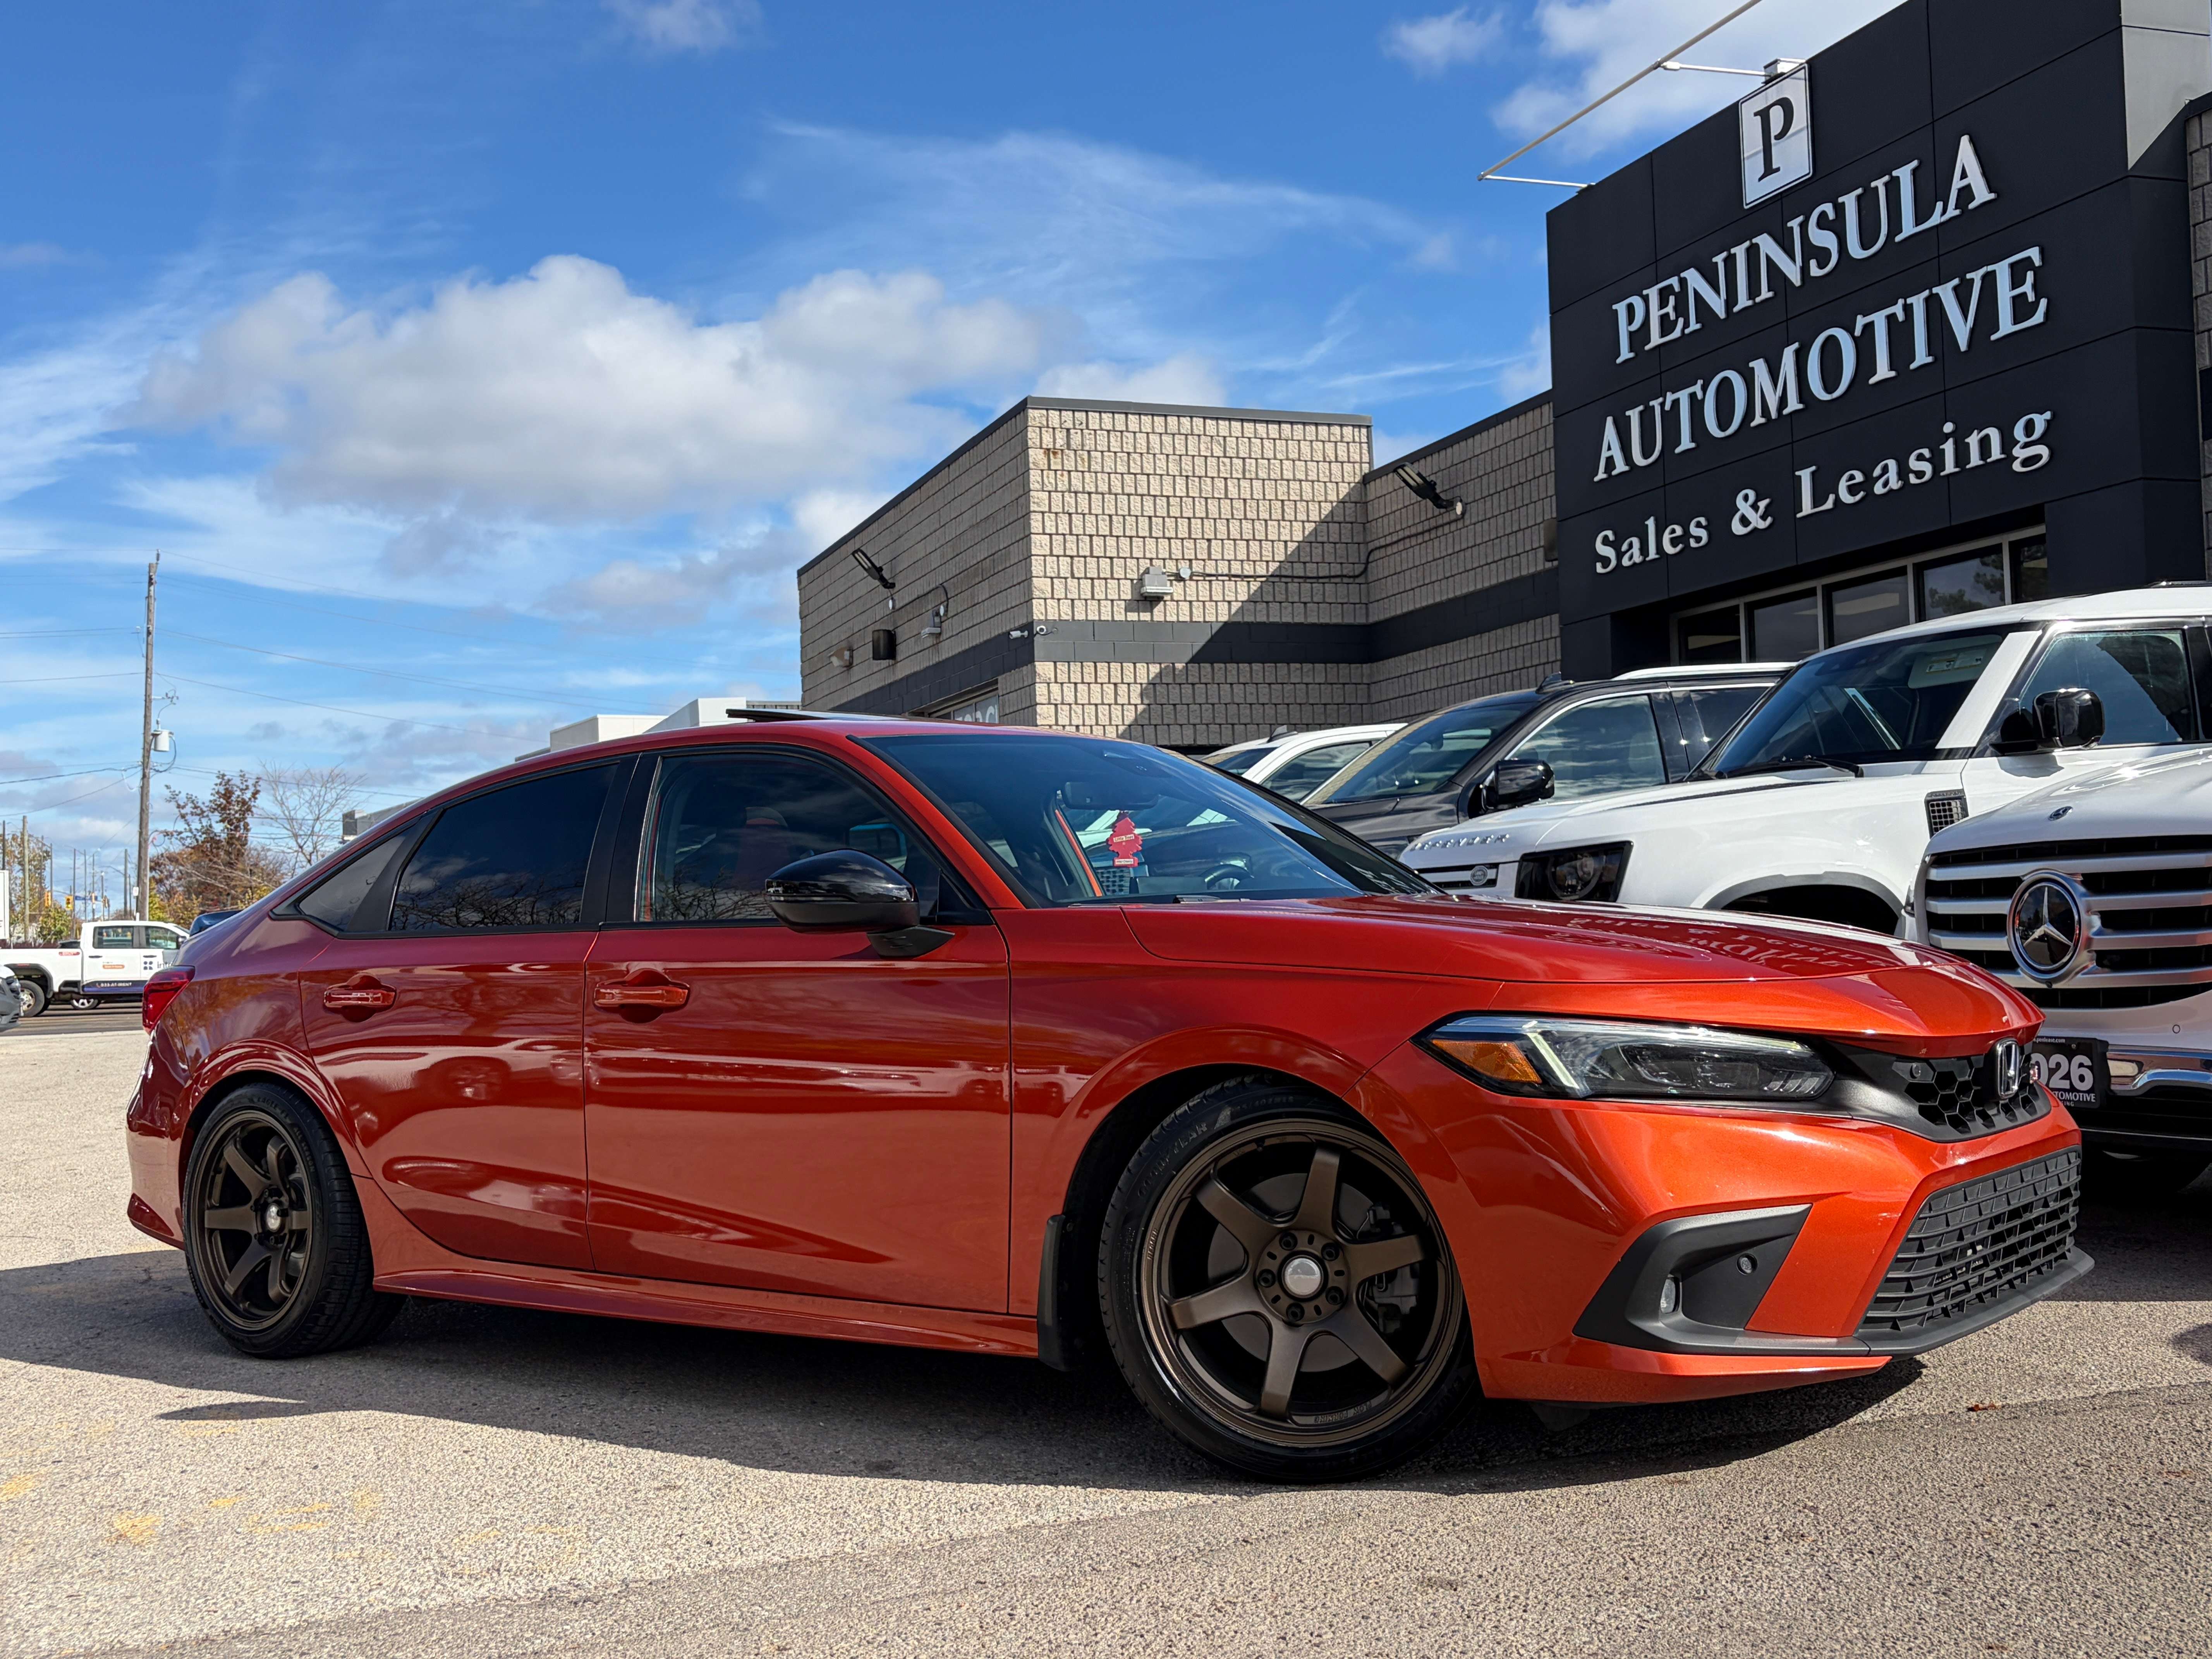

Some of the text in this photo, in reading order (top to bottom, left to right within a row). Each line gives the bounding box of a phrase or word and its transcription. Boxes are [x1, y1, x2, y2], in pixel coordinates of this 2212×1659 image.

[1753, 96, 1794, 182] P
[1612, 134, 1997, 364] PENINSULA
[1593, 246, 2048, 482] AUTOMOTIVE
[1594, 410, 2054, 574] Sales & Leasing
